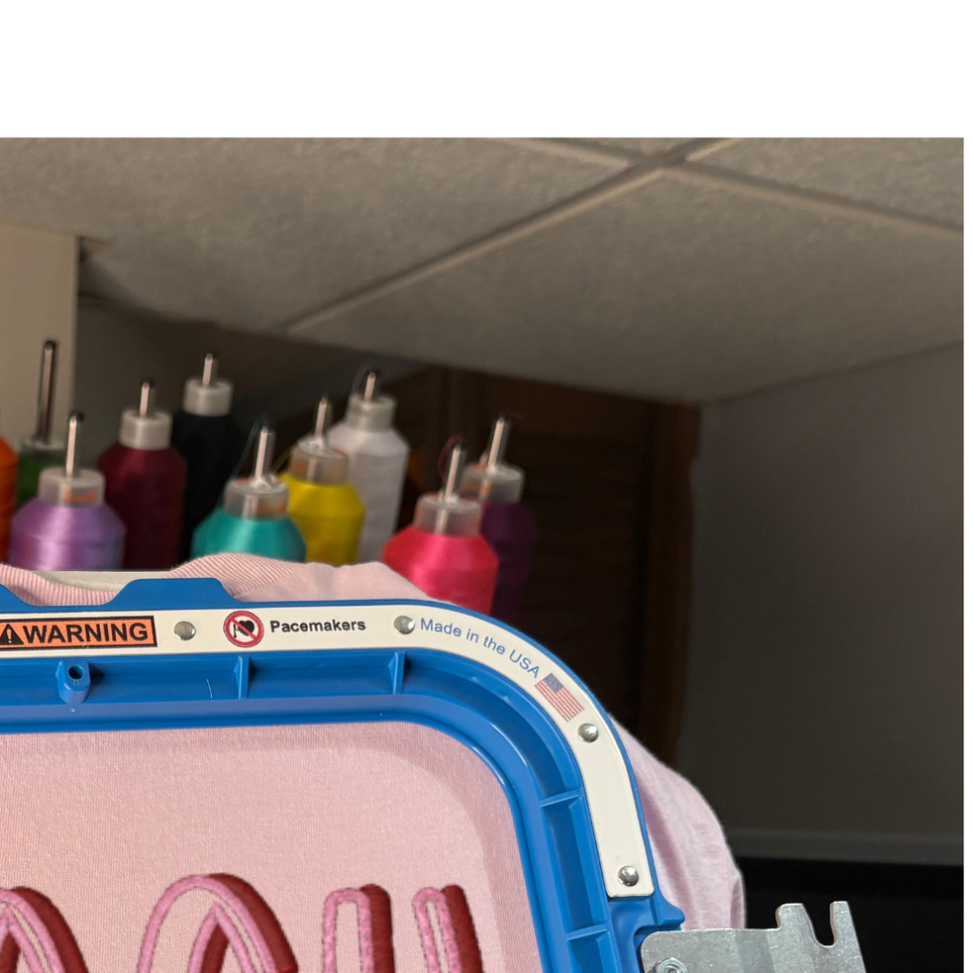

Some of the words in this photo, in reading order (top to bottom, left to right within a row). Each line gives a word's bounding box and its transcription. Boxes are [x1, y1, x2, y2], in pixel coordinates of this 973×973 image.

[23, 622, 148, 644] WARNING
[270, 616, 366, 634] Pacemakers
[420, 618, 462, 637] Made
[466, 628, 479, 643] in
[483, 636, 506, 655] the
[509, 649, 540, 679] USA
